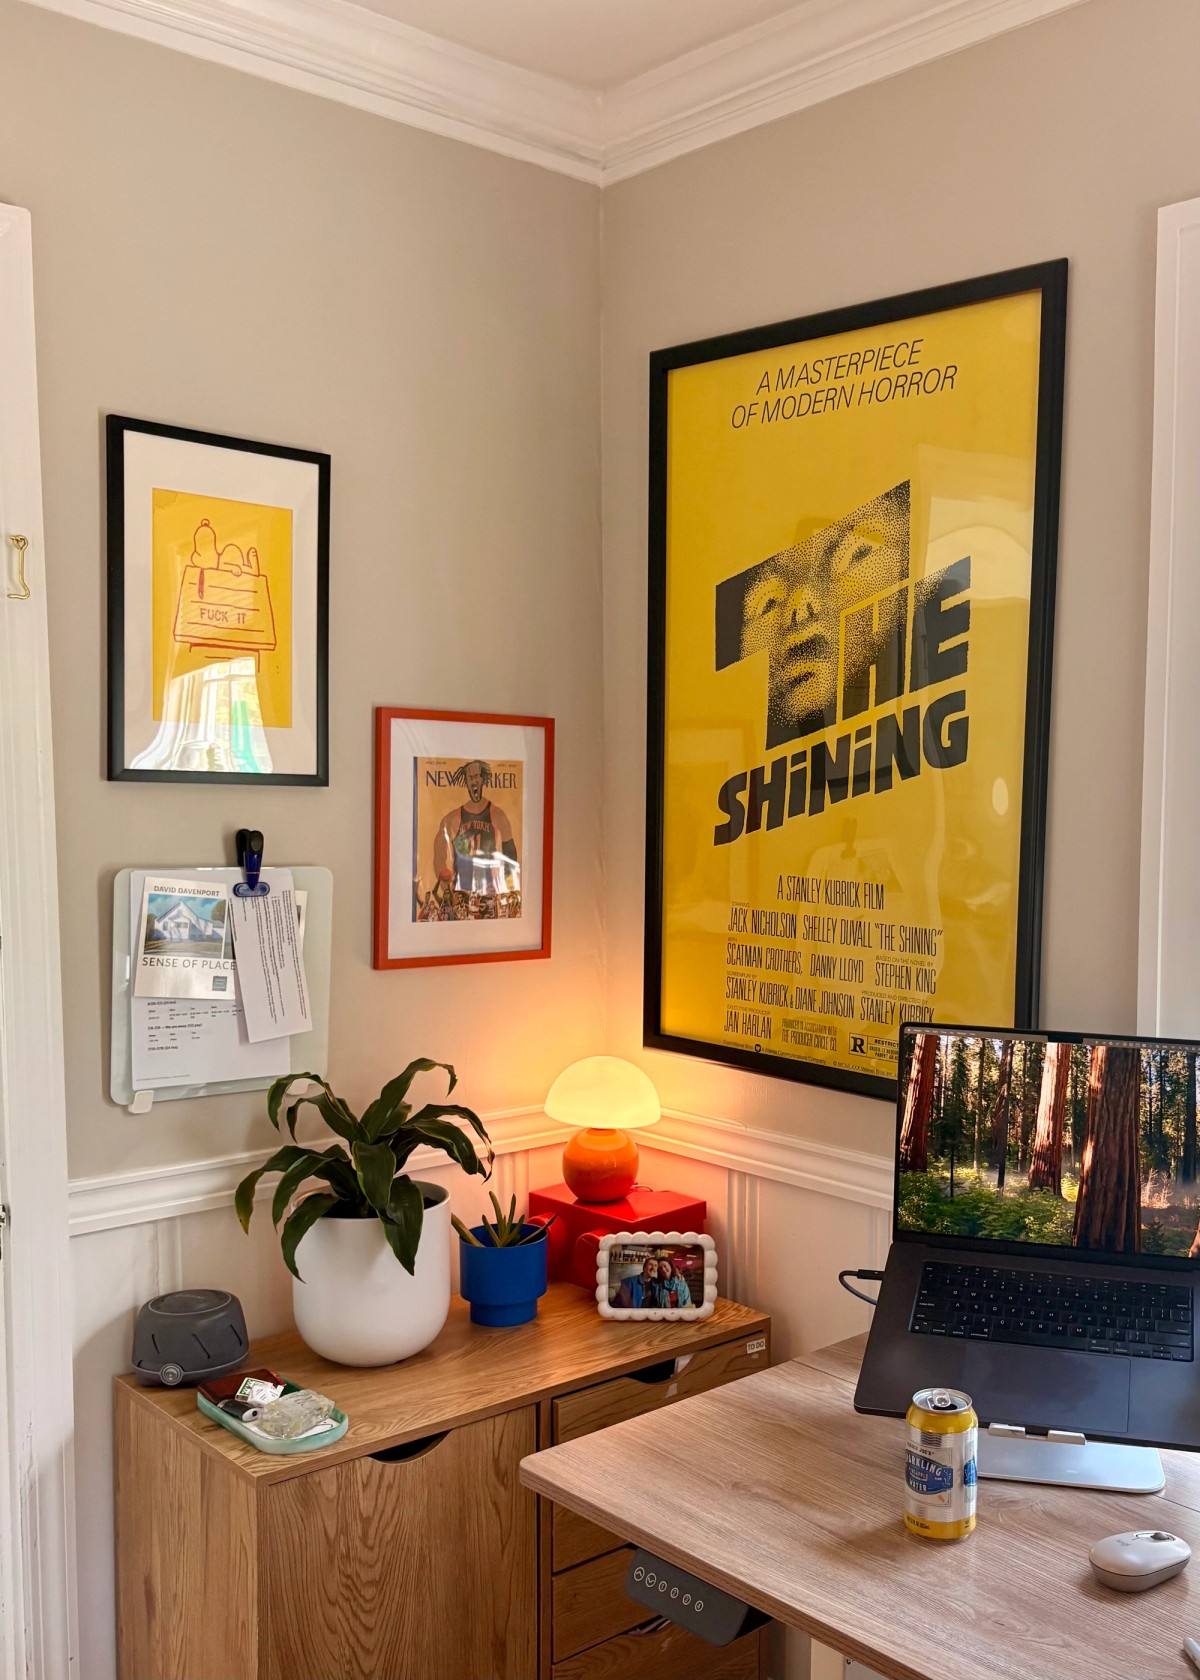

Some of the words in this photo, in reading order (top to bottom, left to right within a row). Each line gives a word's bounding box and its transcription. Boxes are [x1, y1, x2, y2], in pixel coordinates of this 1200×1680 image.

[756, 371, 770, 395] A
[775, 339, 924, 392] MASTERPIECE
[731, 402, 759, 428] OF
[761, 384, 855, 424] MODERN
[858, 365, 958, 406] HORROR
[200, 607, 228, 622] FUCK
[237, 612, 247, 624] IT
[715, 478, 971, 751] THE
[426, 770, 456, 788] NEW
[154, 885, 177, 893] DAVID
[178, 887, 220, 896] DAVENPORT
[777, 875, 784, 900] A
[786, 875, 822, 904] STANLEY
[824, 878, 860, 908] KUBRICK
[864, 882, 884, 910] FILM
[728, 906, 748, 933] JACK
[751, 909, 797, 939] NICHOLSON
[802, 914, 838, 944] SHELLEY
[840, 918, 872, 948] DUVALL
[142, 956, 178, 968] SENSE
[182, 959, 198, 968] OF
[202, 960, 236, 970] PLACE
[726, 942, 762, 968] SCATMAN
[765, 948, 802, 976] CROTHERS,
[810, 954, 838, 980] DANNY
[839, 958, 864, 984] LLOYD
[875, 962, 911, 990] STEPHEN
[916, 967, 937, 995] KING
[726, 976, 757, 1003] STANLEY
[759, 981, 789, 1008] KUBRICK
[795, 986, 817, 1013] DIANE
[819, 990, 855, 1019] JOHNSON
[860, 996, 896, 1025] STANLEY
[899, 1002, 935, 1024] KUBRICK
[724, 1010, 739, 1033] JAN
[741, 1013, 772, 1040] HARLAN
[850, 1036, 866, 1054] R
[874, 1039, 898, 1048] RESTRICT
[910, 1479, 927, 1491] WATER
